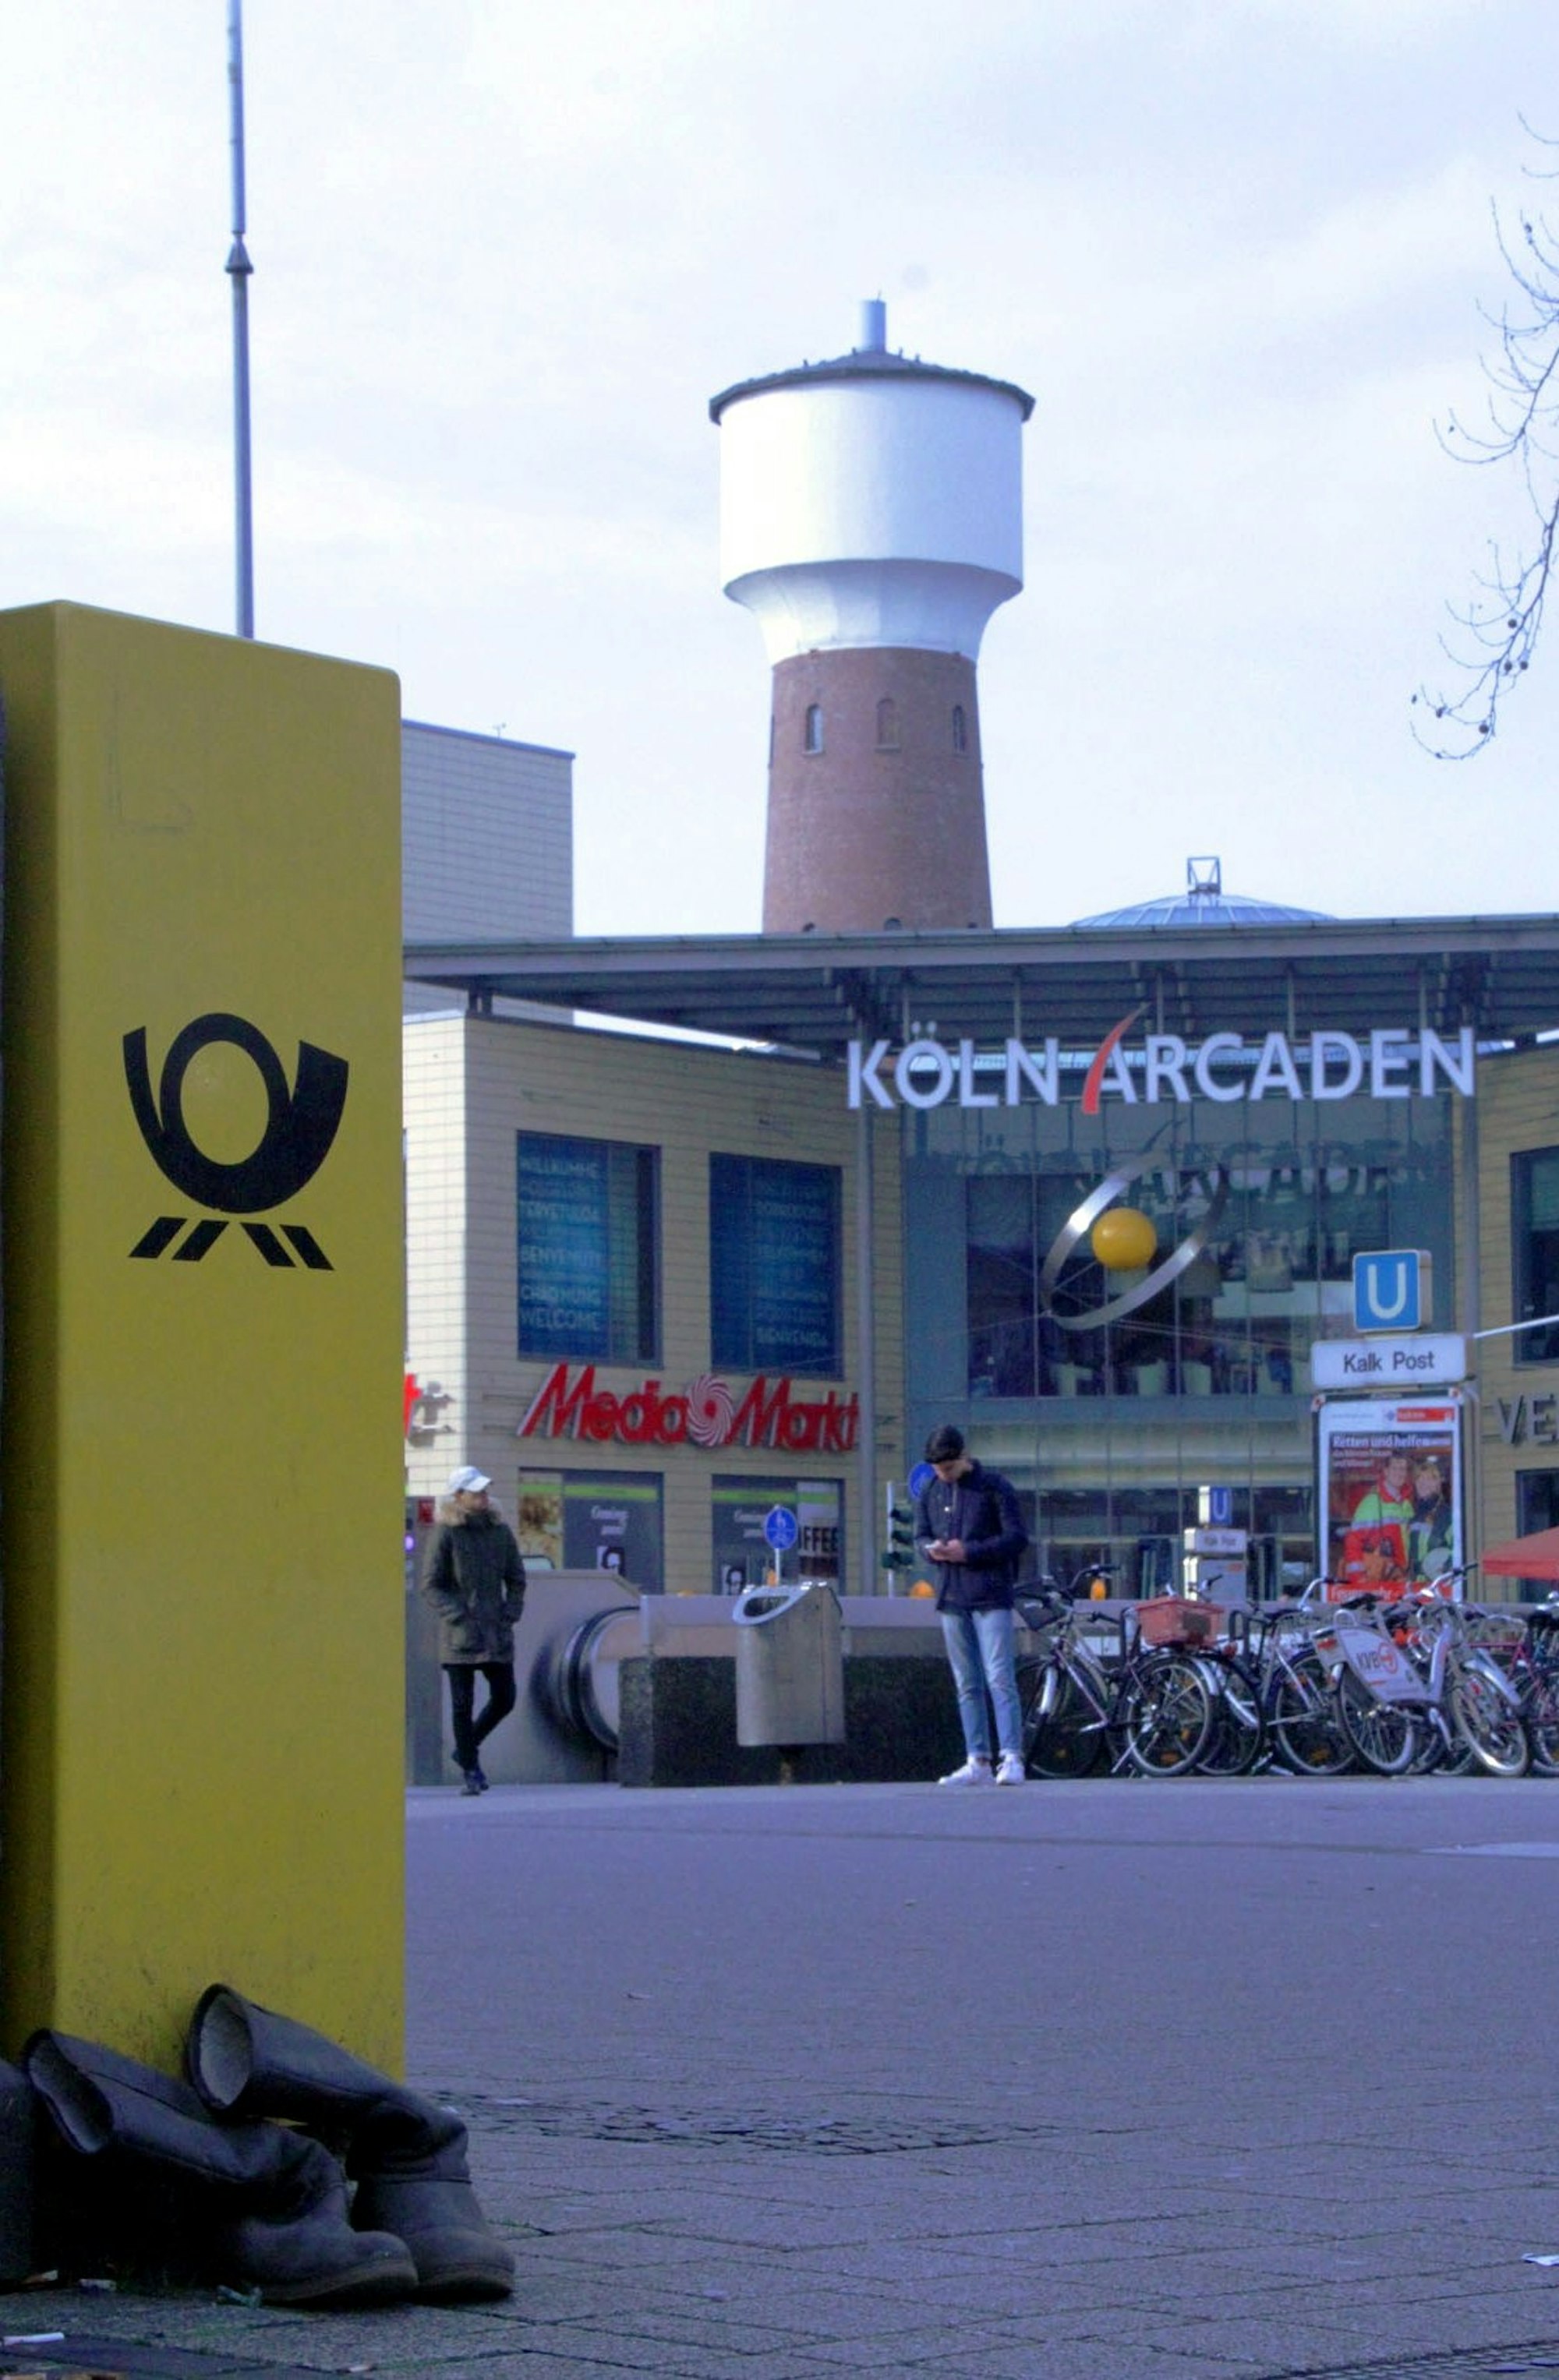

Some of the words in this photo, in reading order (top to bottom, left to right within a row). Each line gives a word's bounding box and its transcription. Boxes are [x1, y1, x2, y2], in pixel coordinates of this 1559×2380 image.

[847, 1021, 1059, 1110] KÖLN
[1082, 1004, 1476, 1114] ARCADEN
[1368, 1262, 1407, 1319] U
[1343, 1352, 1384, 1373] Kalk
[1392, 1351, 1436, 1371] Post
[516, 1360, 688, 1444] Media
[723, 1374, 859, 1451] Markt
[1494, 1393, 1559, 1446] VE
[1333, 1436, 1370, 1448] Retten
[1371, 1435, 1393, 1447] und
[1213, 1491, 1228, 1520] U
[1356, 1650, 1381, 1670] KVB
